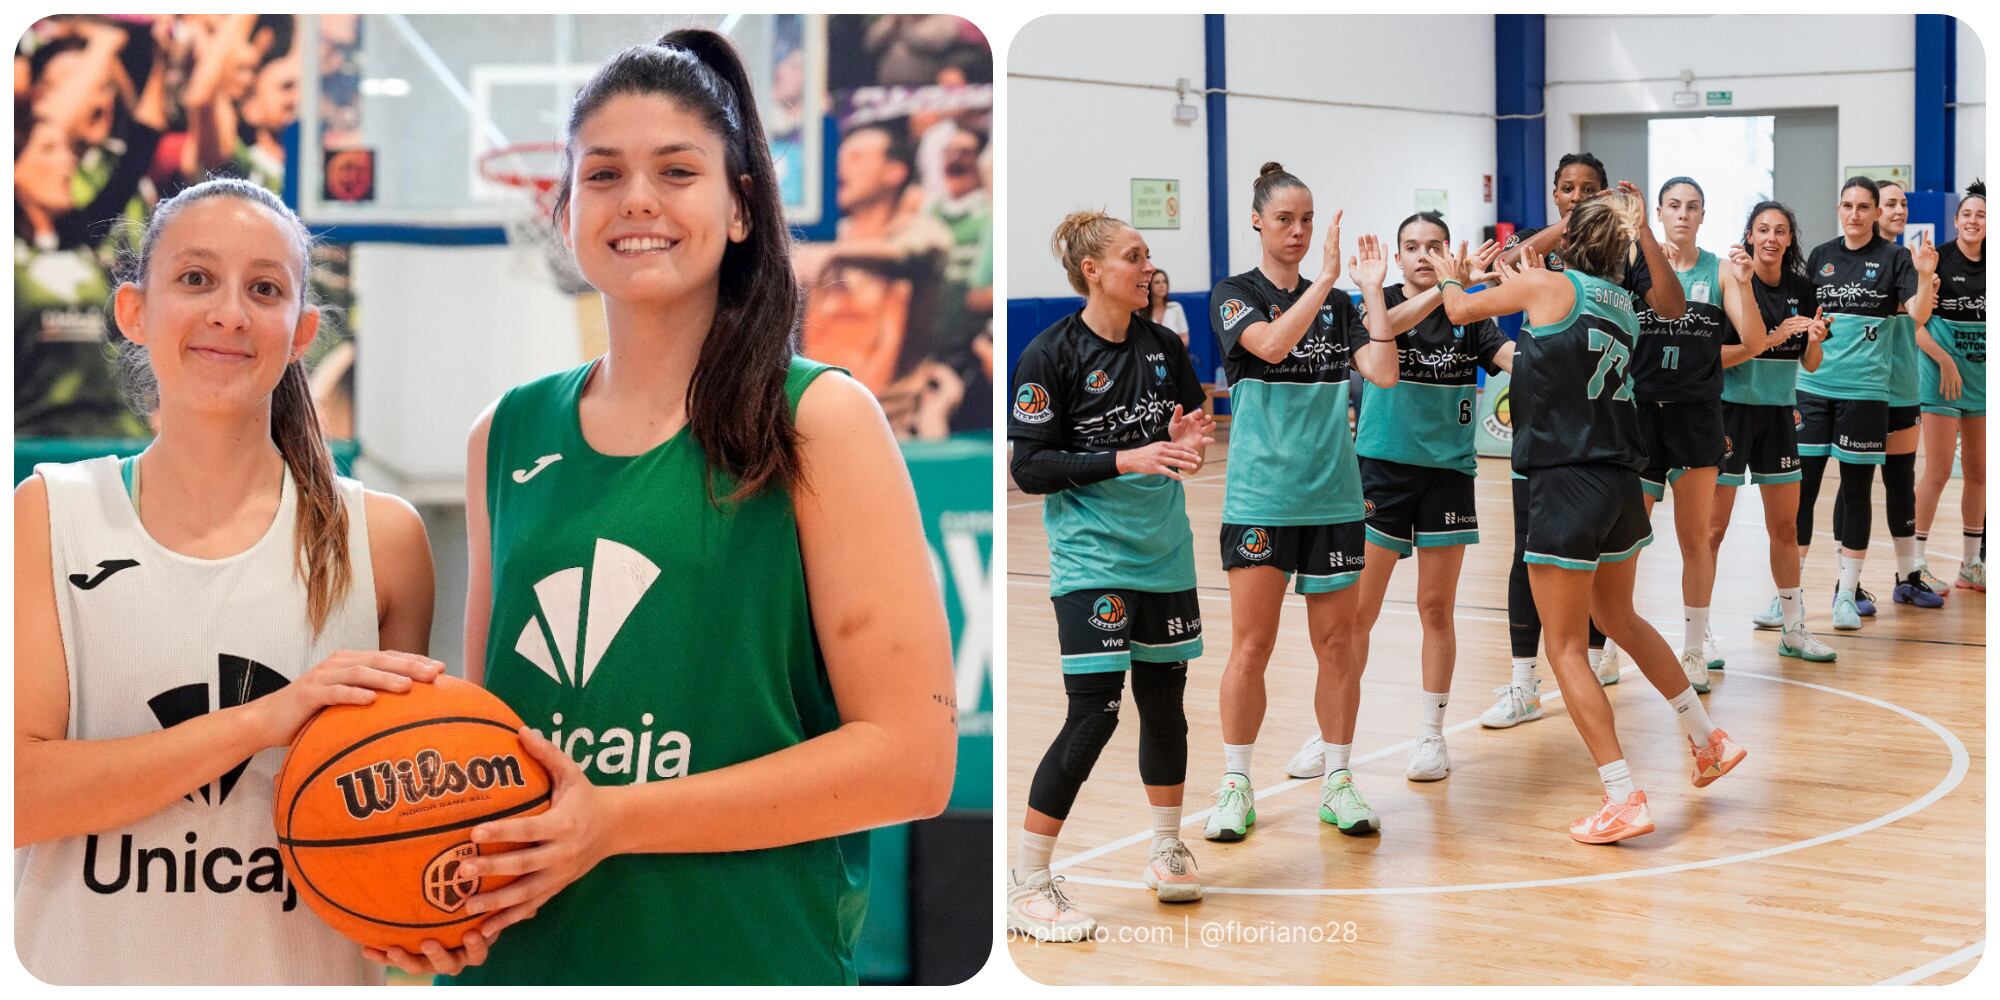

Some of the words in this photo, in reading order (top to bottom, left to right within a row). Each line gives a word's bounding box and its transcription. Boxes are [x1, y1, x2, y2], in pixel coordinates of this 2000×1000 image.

[1940, 295, 1987, 319] Estep
[1457, 398, 1473, 426] 6
[1485, 418, 1513, 439] ESTE
[1456, 515, 1477, 524] Hosp
[1102, 637, 1124, 647] vive
[551, 712, 692, 786] icaja
[335, 748, 526, 820] Wilson
[399, 804, 437, 816] INDOOR
[439, 798, 466, 808] GAME
[468, 794, 492, 803] BALL
[455, 847, 473, 857] FEB
[83, 831, 297, 912] Unicaj
